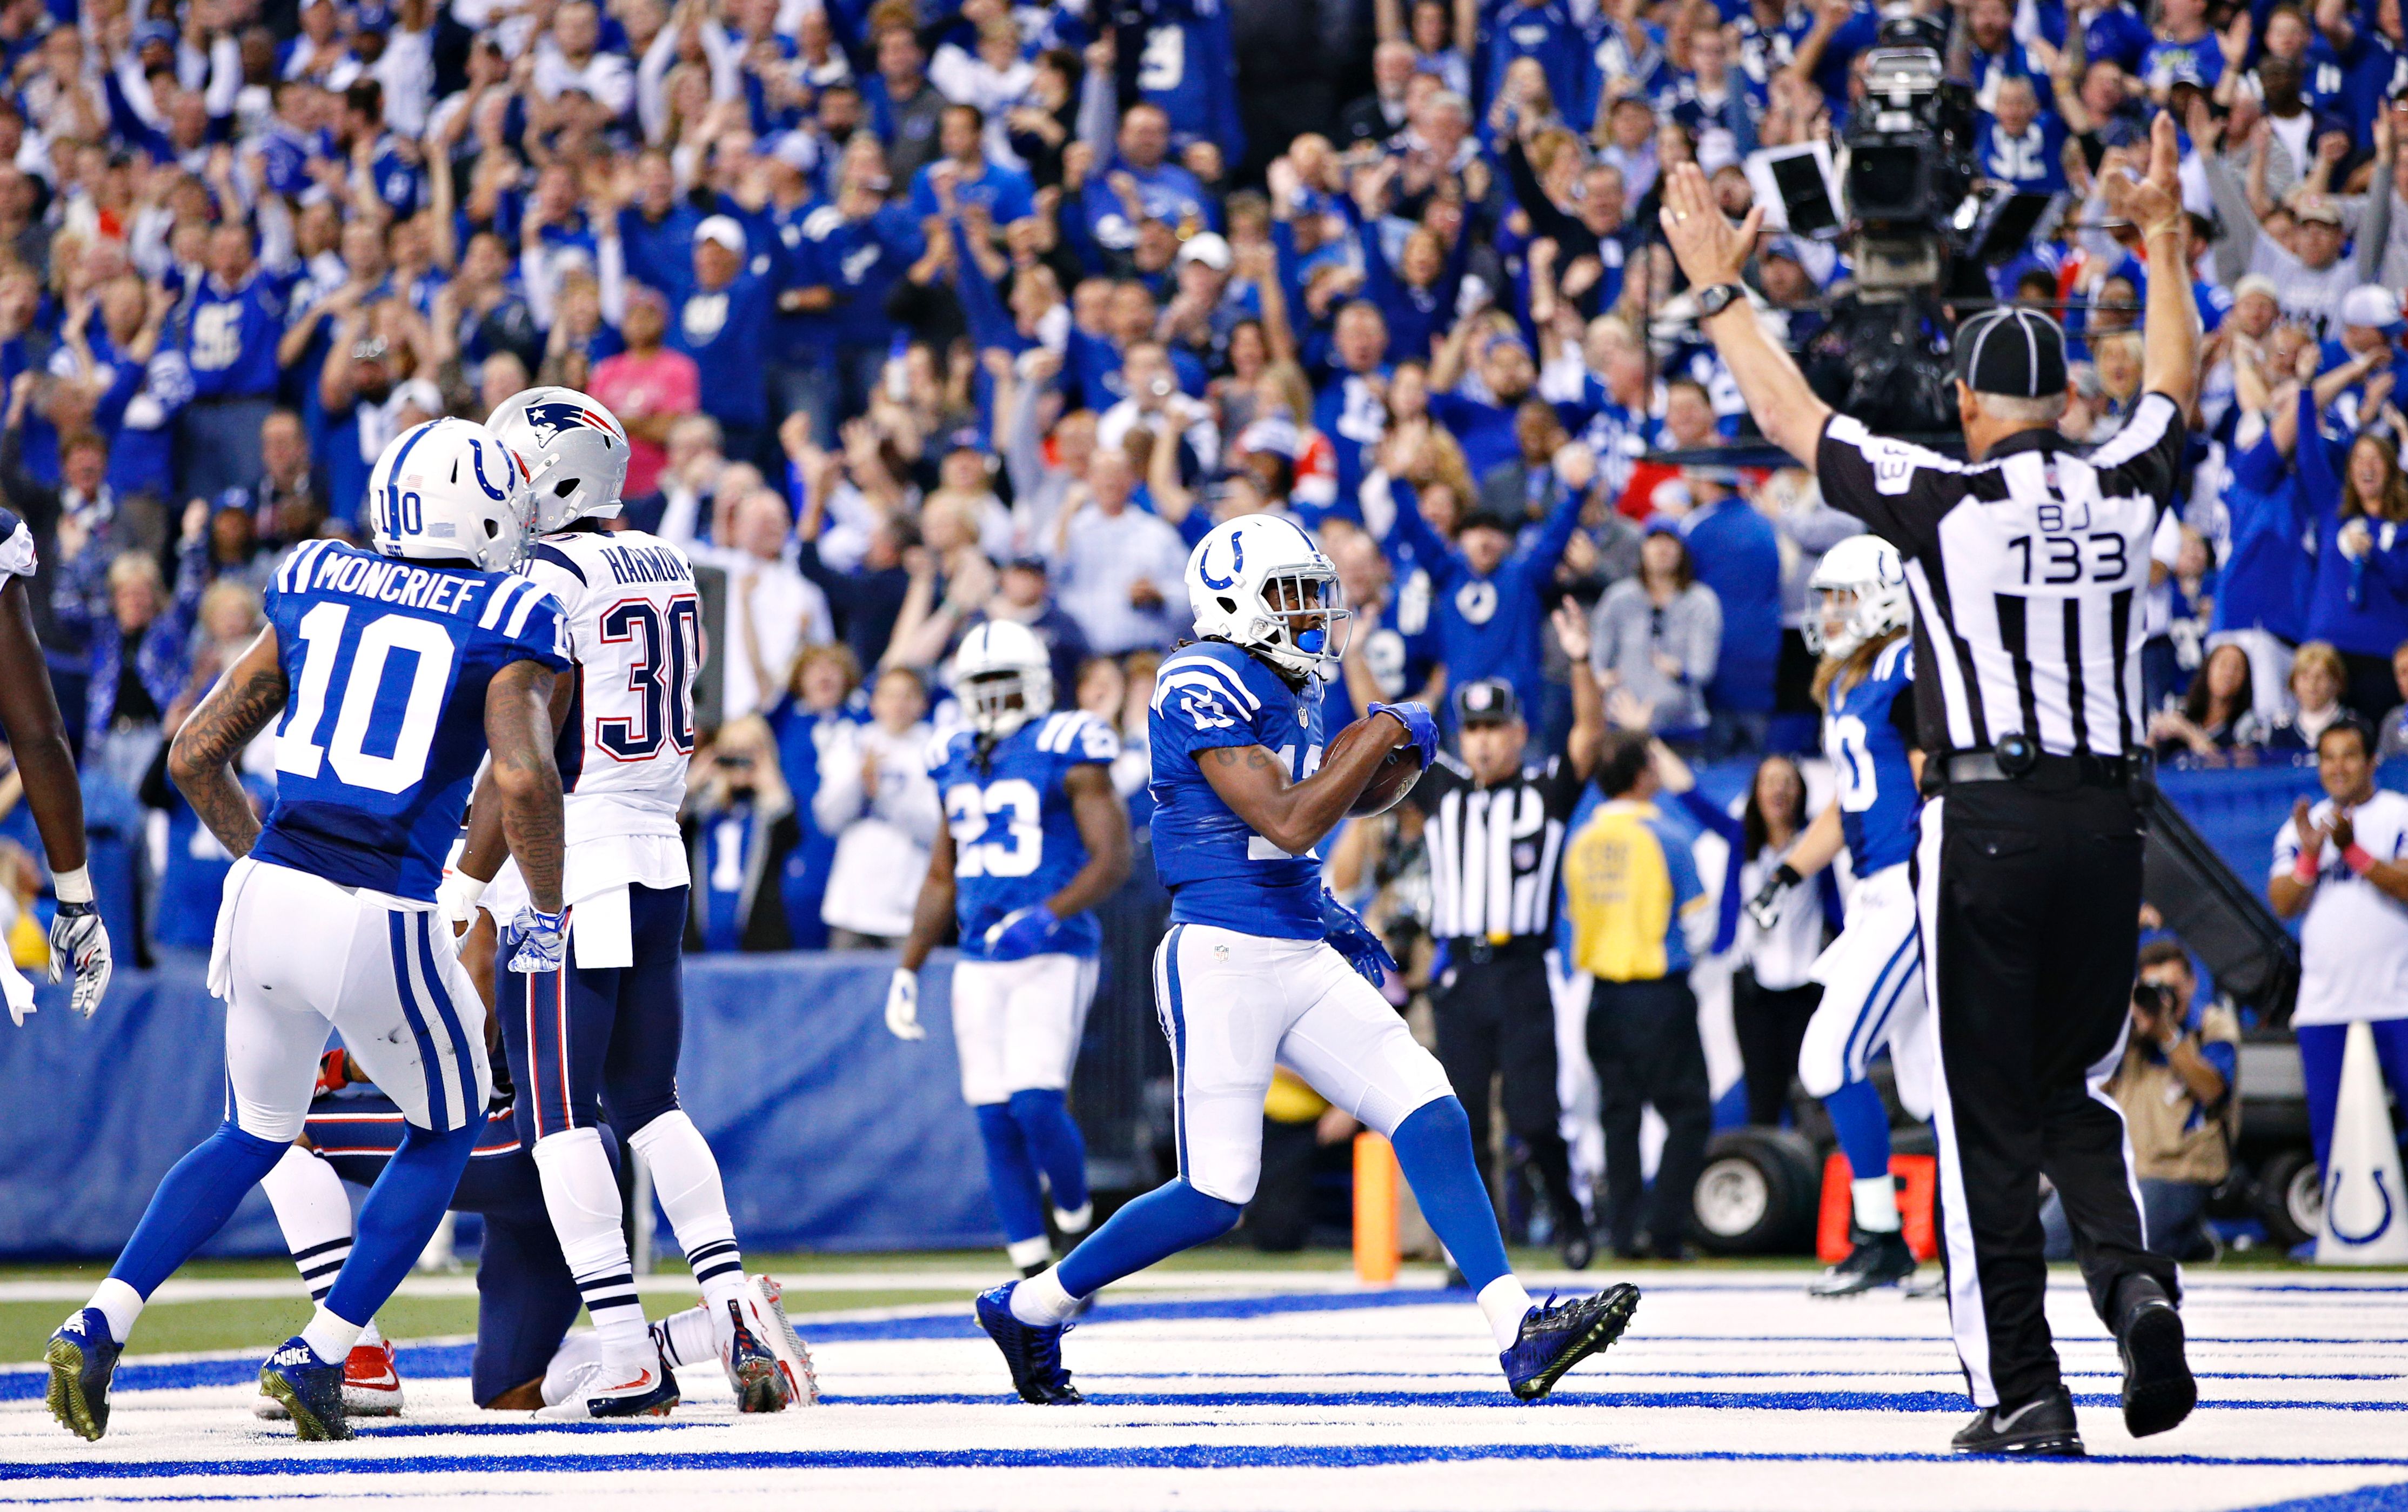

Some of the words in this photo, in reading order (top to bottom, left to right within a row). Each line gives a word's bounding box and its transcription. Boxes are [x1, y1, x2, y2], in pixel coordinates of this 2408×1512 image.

[2038, 503, 2090, 532] BJ
[313, 551, 486, 615] MONCRIEF
[599, 546, 691, 585] HARMON
[2009, 533, 2128, 585] 133
[275, 601, 456, 795] 10
[596, 593, 700, 762] 30
[946, 779, 1043, 878] 23
[274, 1347, 311, 1367] NIKE
